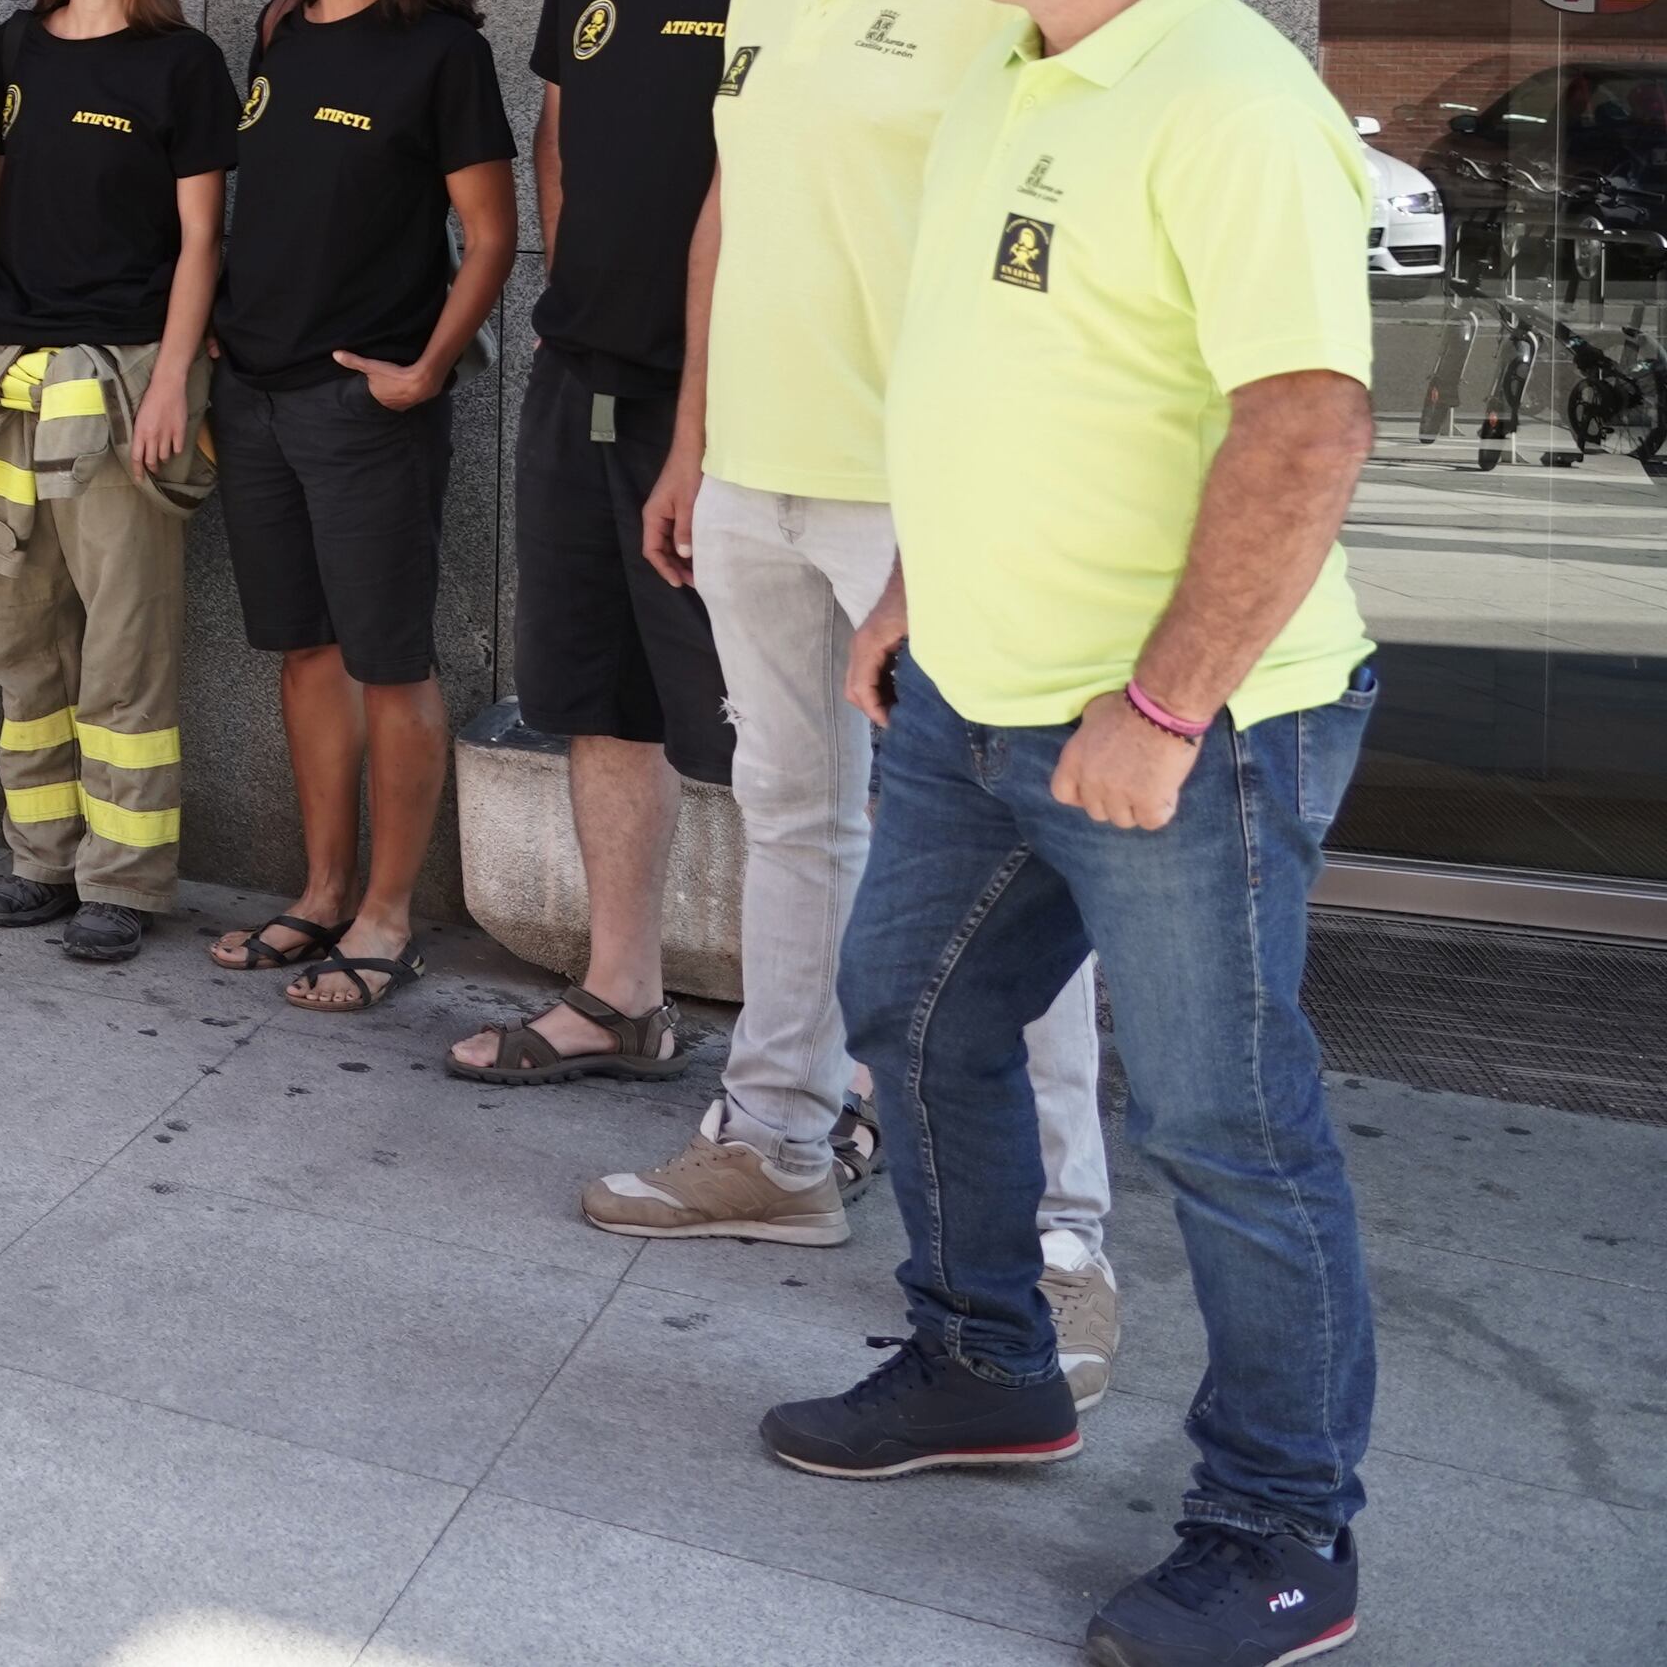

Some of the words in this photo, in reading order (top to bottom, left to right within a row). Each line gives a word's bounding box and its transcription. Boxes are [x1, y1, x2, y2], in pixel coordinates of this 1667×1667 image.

[660, 19, 726, 38] ATIFCYL
[71, 109, 133, 134] ATIFCYL
[313, 105, 372, 131] ATIFCYL
[1268, 1588, 1305, 1613] FILA
